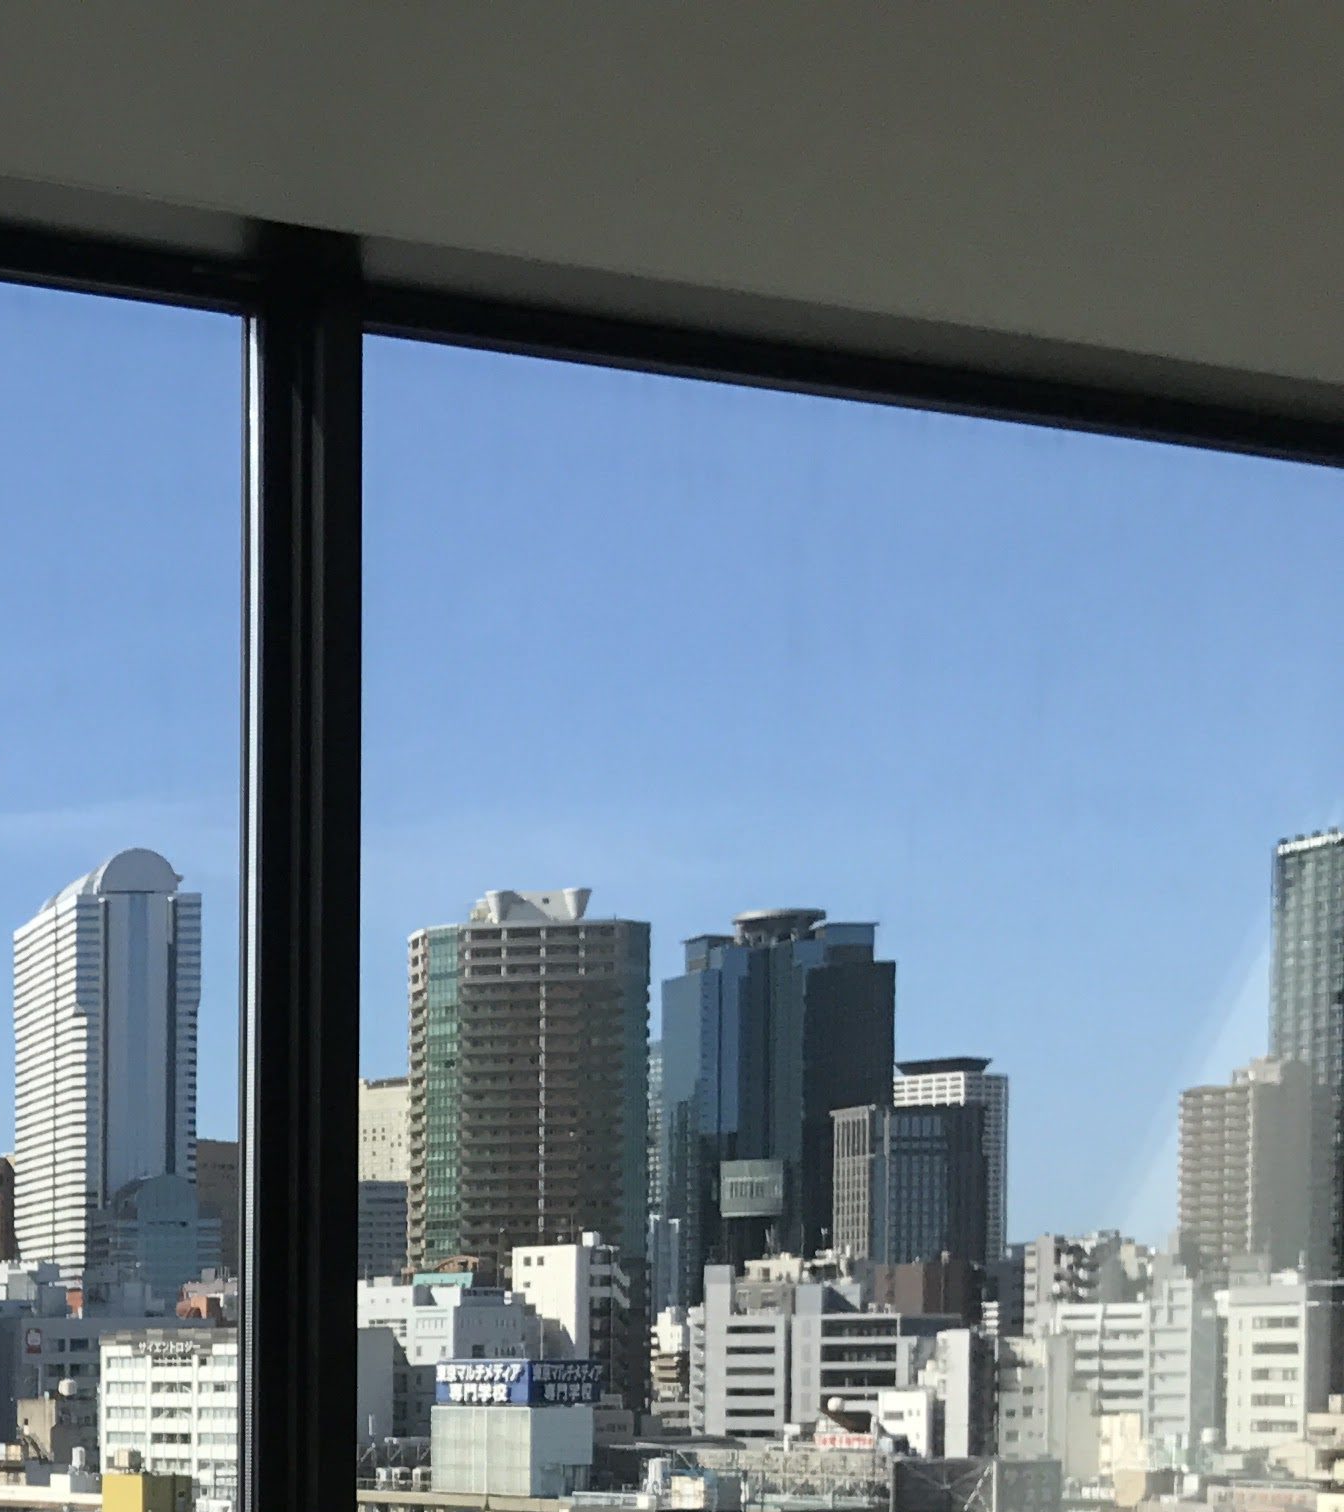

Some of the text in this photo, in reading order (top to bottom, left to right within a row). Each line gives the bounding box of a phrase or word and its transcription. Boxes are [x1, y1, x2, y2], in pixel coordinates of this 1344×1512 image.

[139, 1341, 201, 1353] サイエントロジー
[449, 1383, 508, 1402] 専門学校
